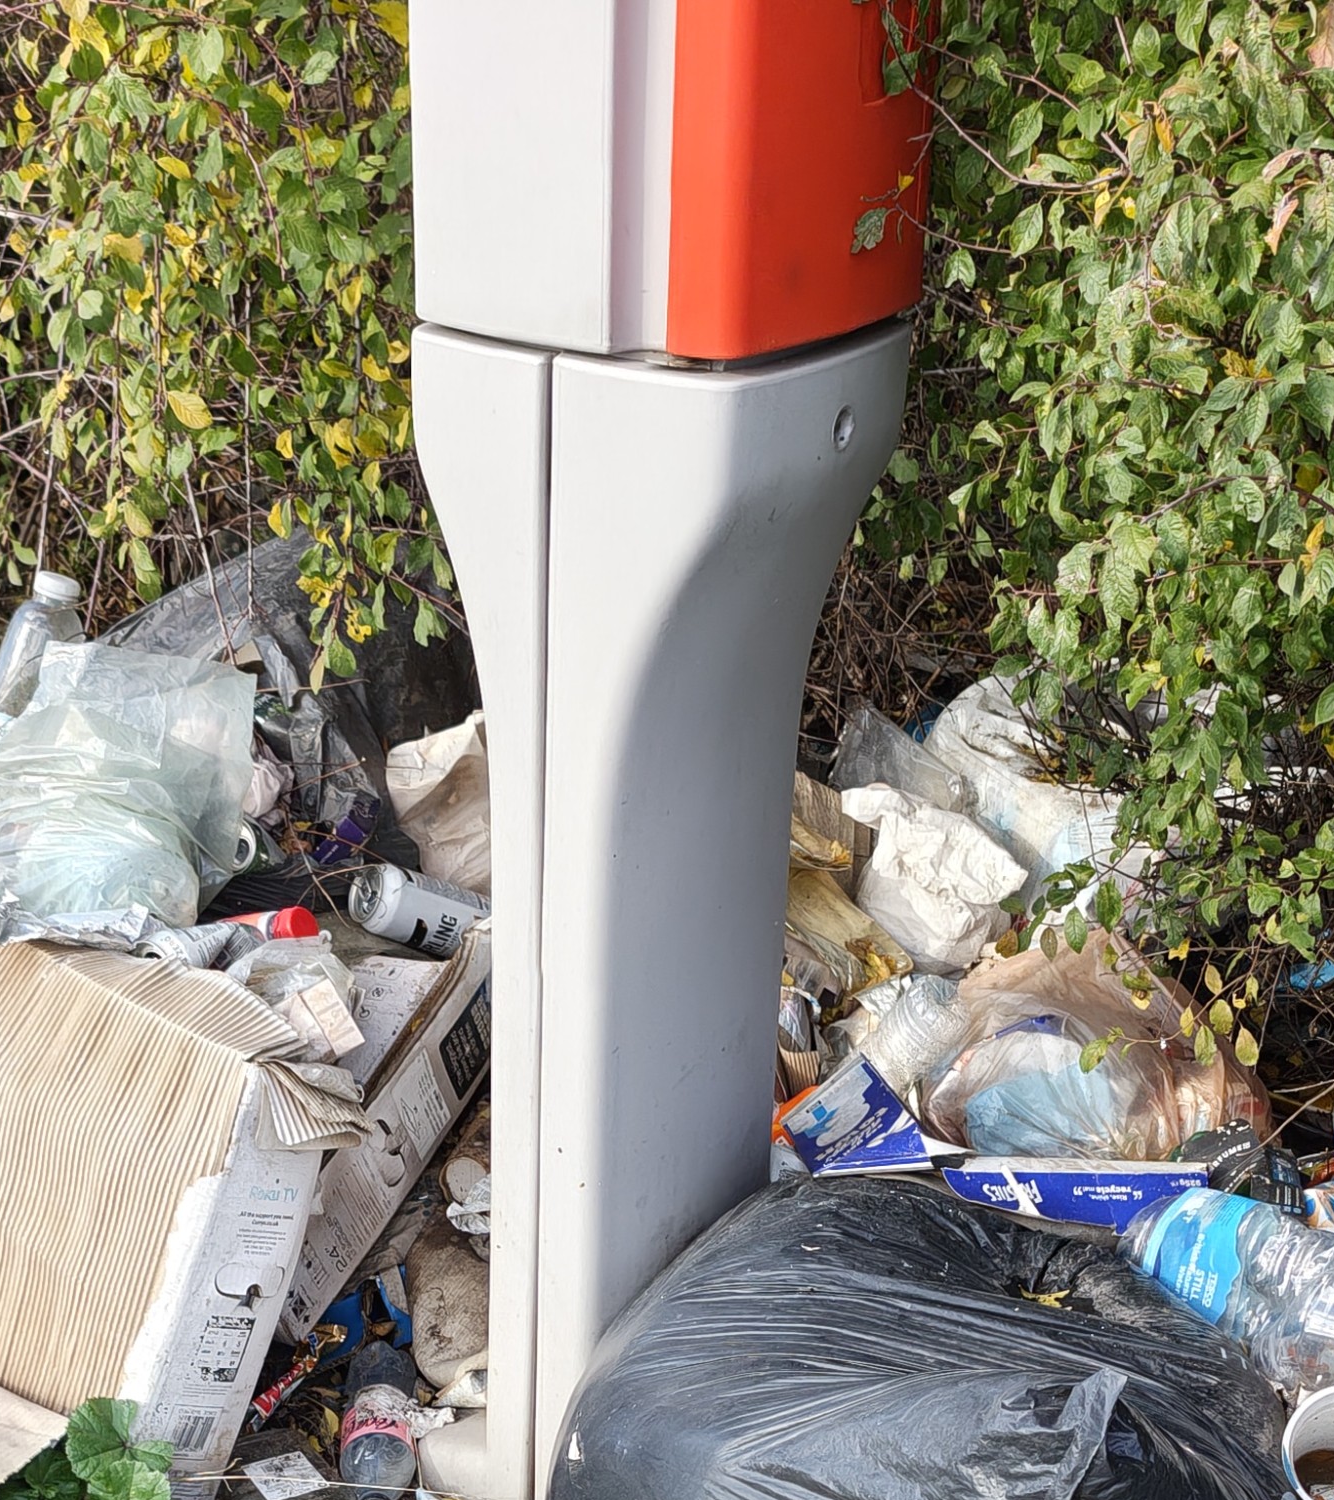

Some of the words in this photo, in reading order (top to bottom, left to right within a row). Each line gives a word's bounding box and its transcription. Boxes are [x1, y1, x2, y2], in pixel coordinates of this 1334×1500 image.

[249, 1185, 280, 1201] Roku
[283, 1187, 299, 1203] TV
[1095, 1184, 1132, 1196] recycle
[1172, 1264, 1187, 1294] Water
[1189, 1268, 1206, 1301] STILL
[1202, 1271, 1219, 1308] TESCO
